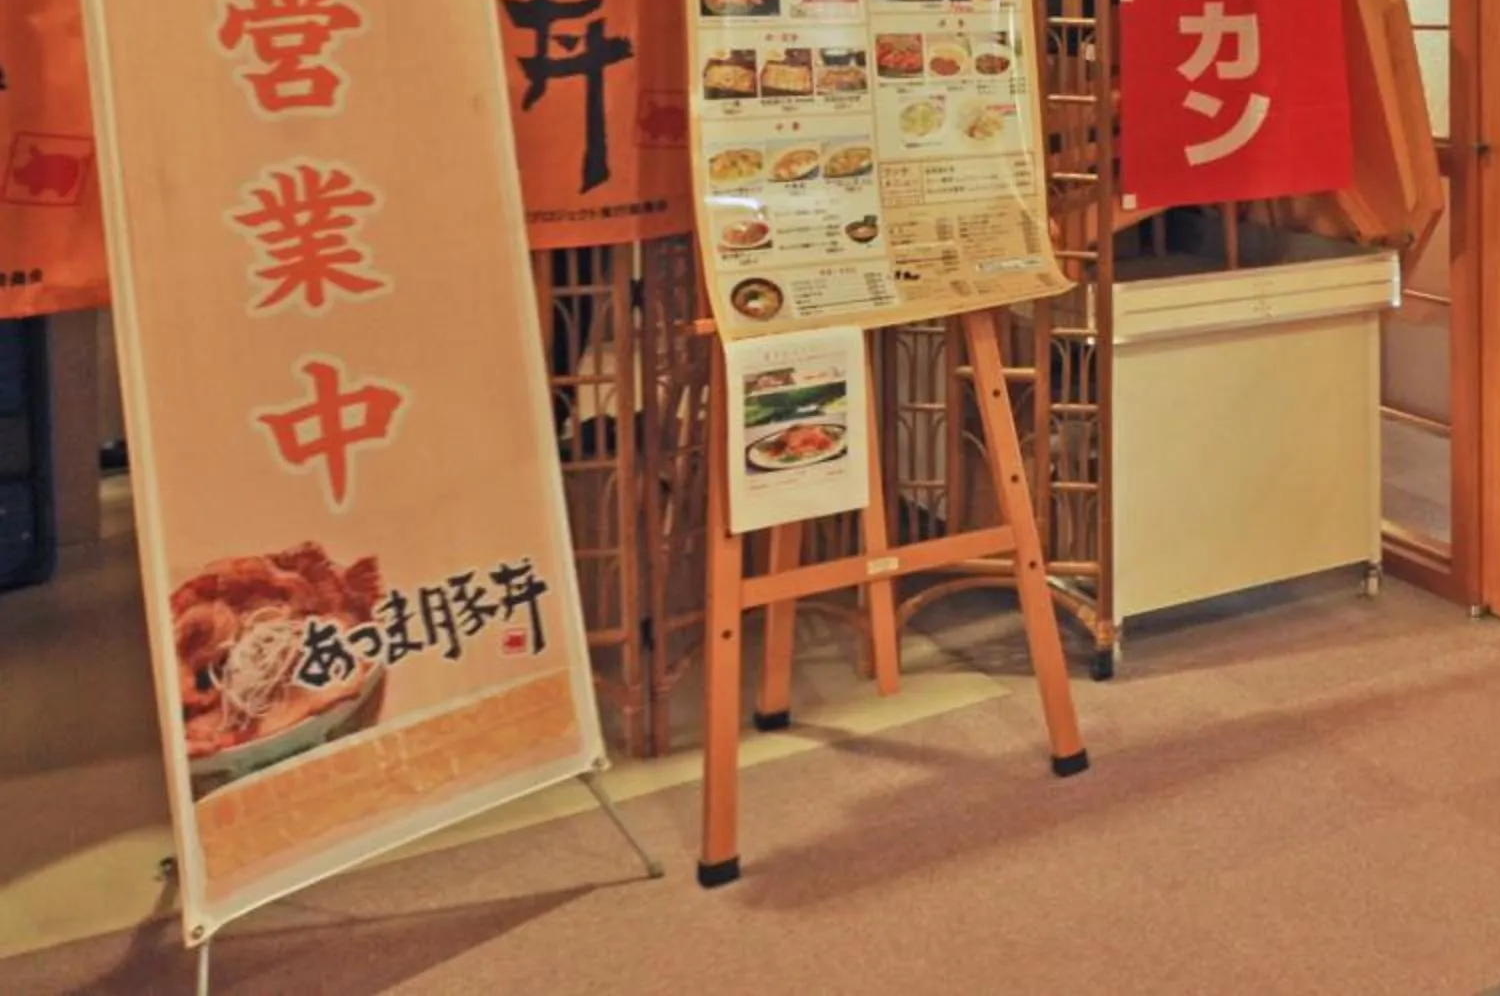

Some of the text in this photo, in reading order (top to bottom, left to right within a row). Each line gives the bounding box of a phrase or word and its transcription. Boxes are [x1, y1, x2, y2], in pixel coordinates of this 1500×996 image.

[297, 558, 548, 688] あつま豚丼
